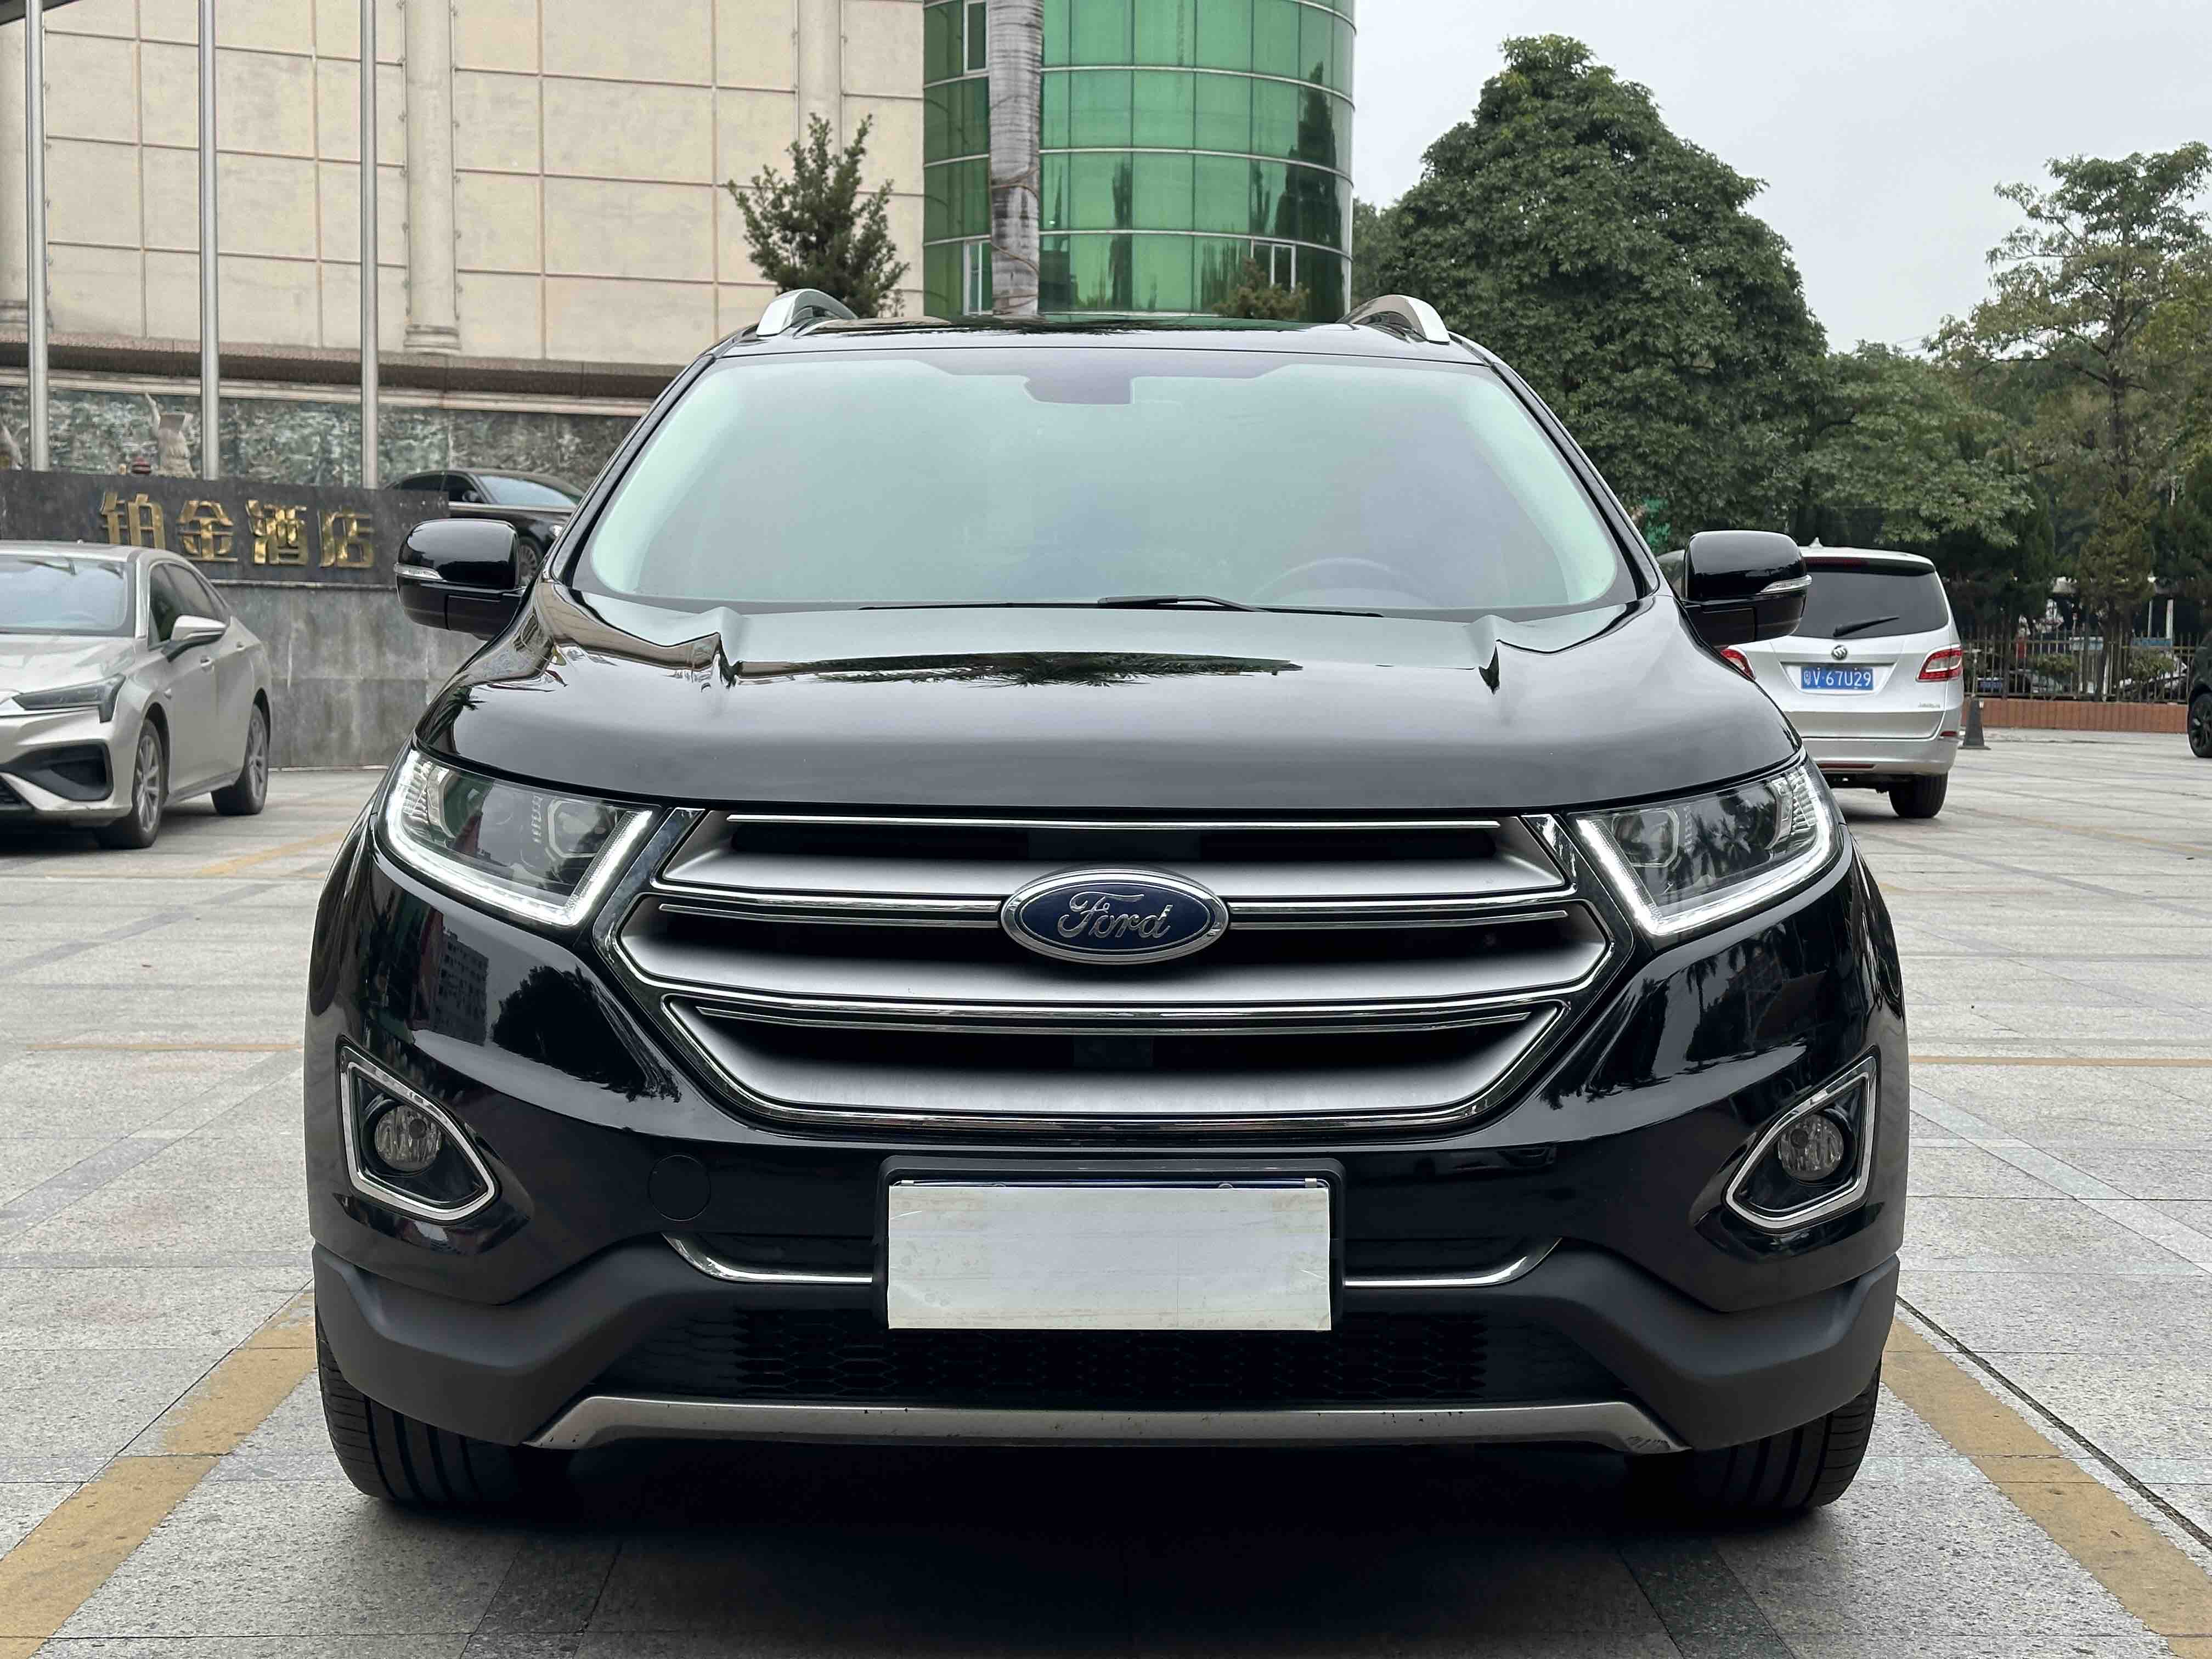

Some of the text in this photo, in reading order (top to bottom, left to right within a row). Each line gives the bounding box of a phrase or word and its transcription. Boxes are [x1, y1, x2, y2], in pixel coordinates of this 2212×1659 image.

[99, 491, 375, 568] 铂金酒店
[1057, 891, 1173, 938] Ford
